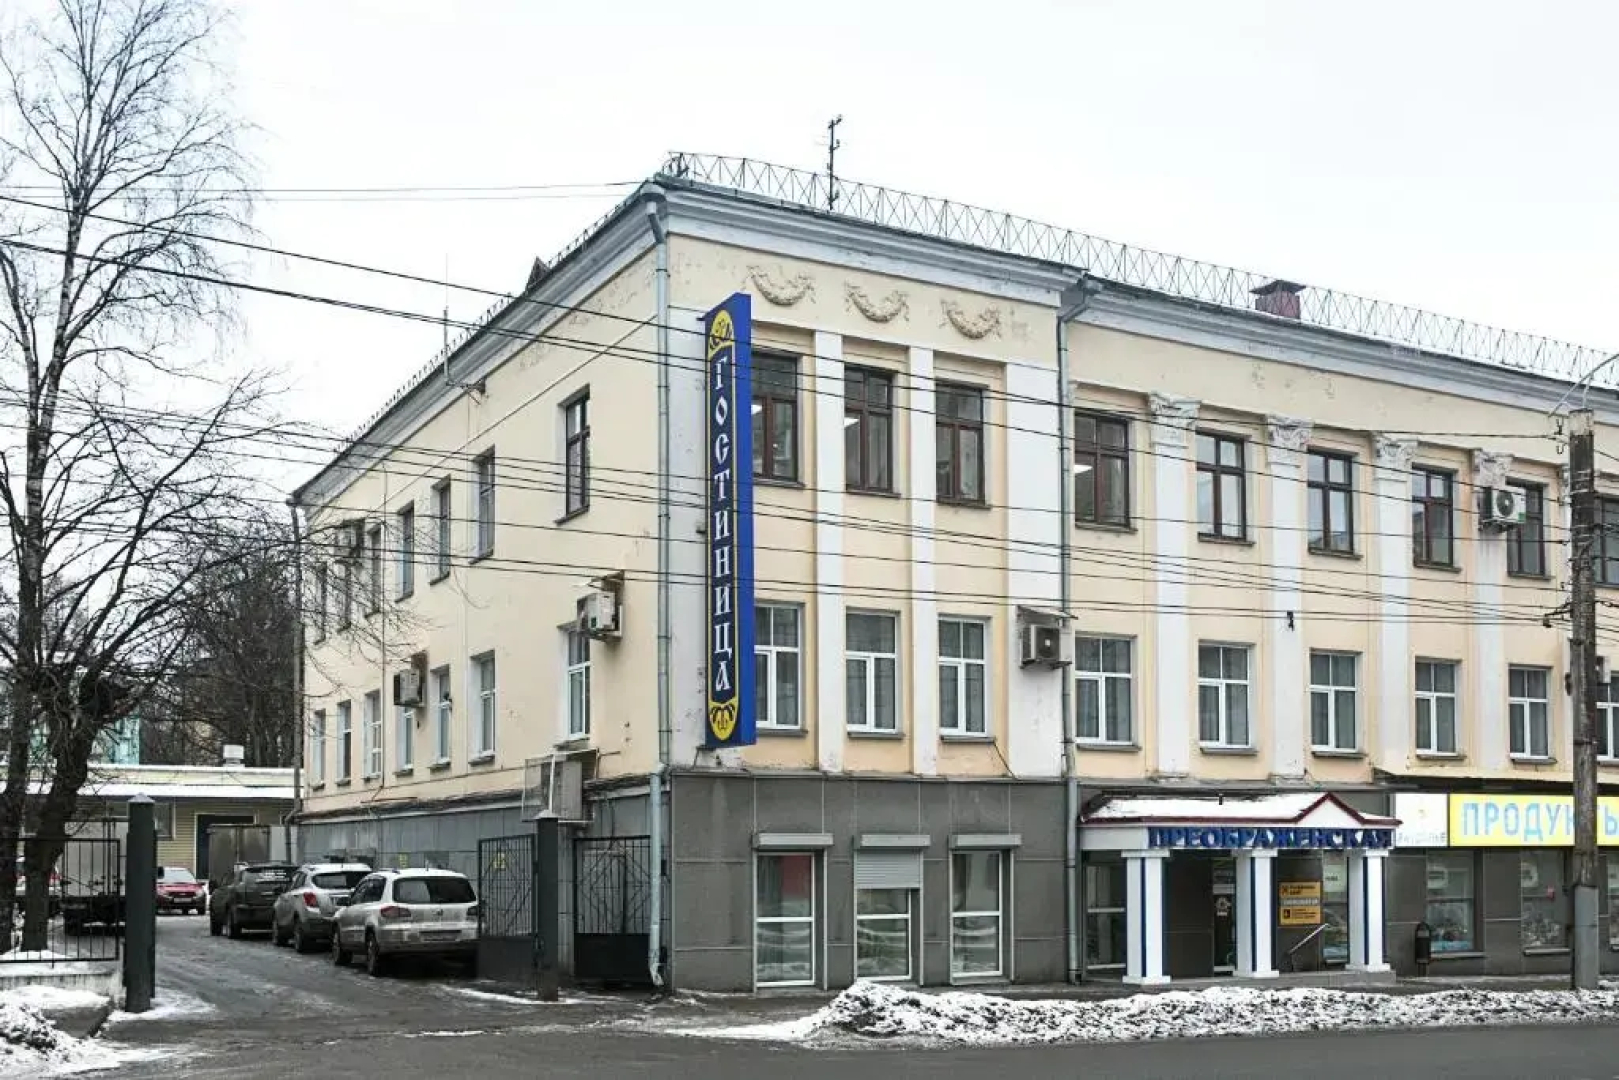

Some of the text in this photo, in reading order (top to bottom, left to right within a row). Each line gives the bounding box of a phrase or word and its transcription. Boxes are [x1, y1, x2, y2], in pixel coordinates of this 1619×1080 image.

[713, 355, 733, 691] ГОСТИНИЦА
[1149, 827, 1392, 849] ПРЕОБРАЖЕНСКАЯ
[1462, 801, 1619, 842] ПРОДУЫ
